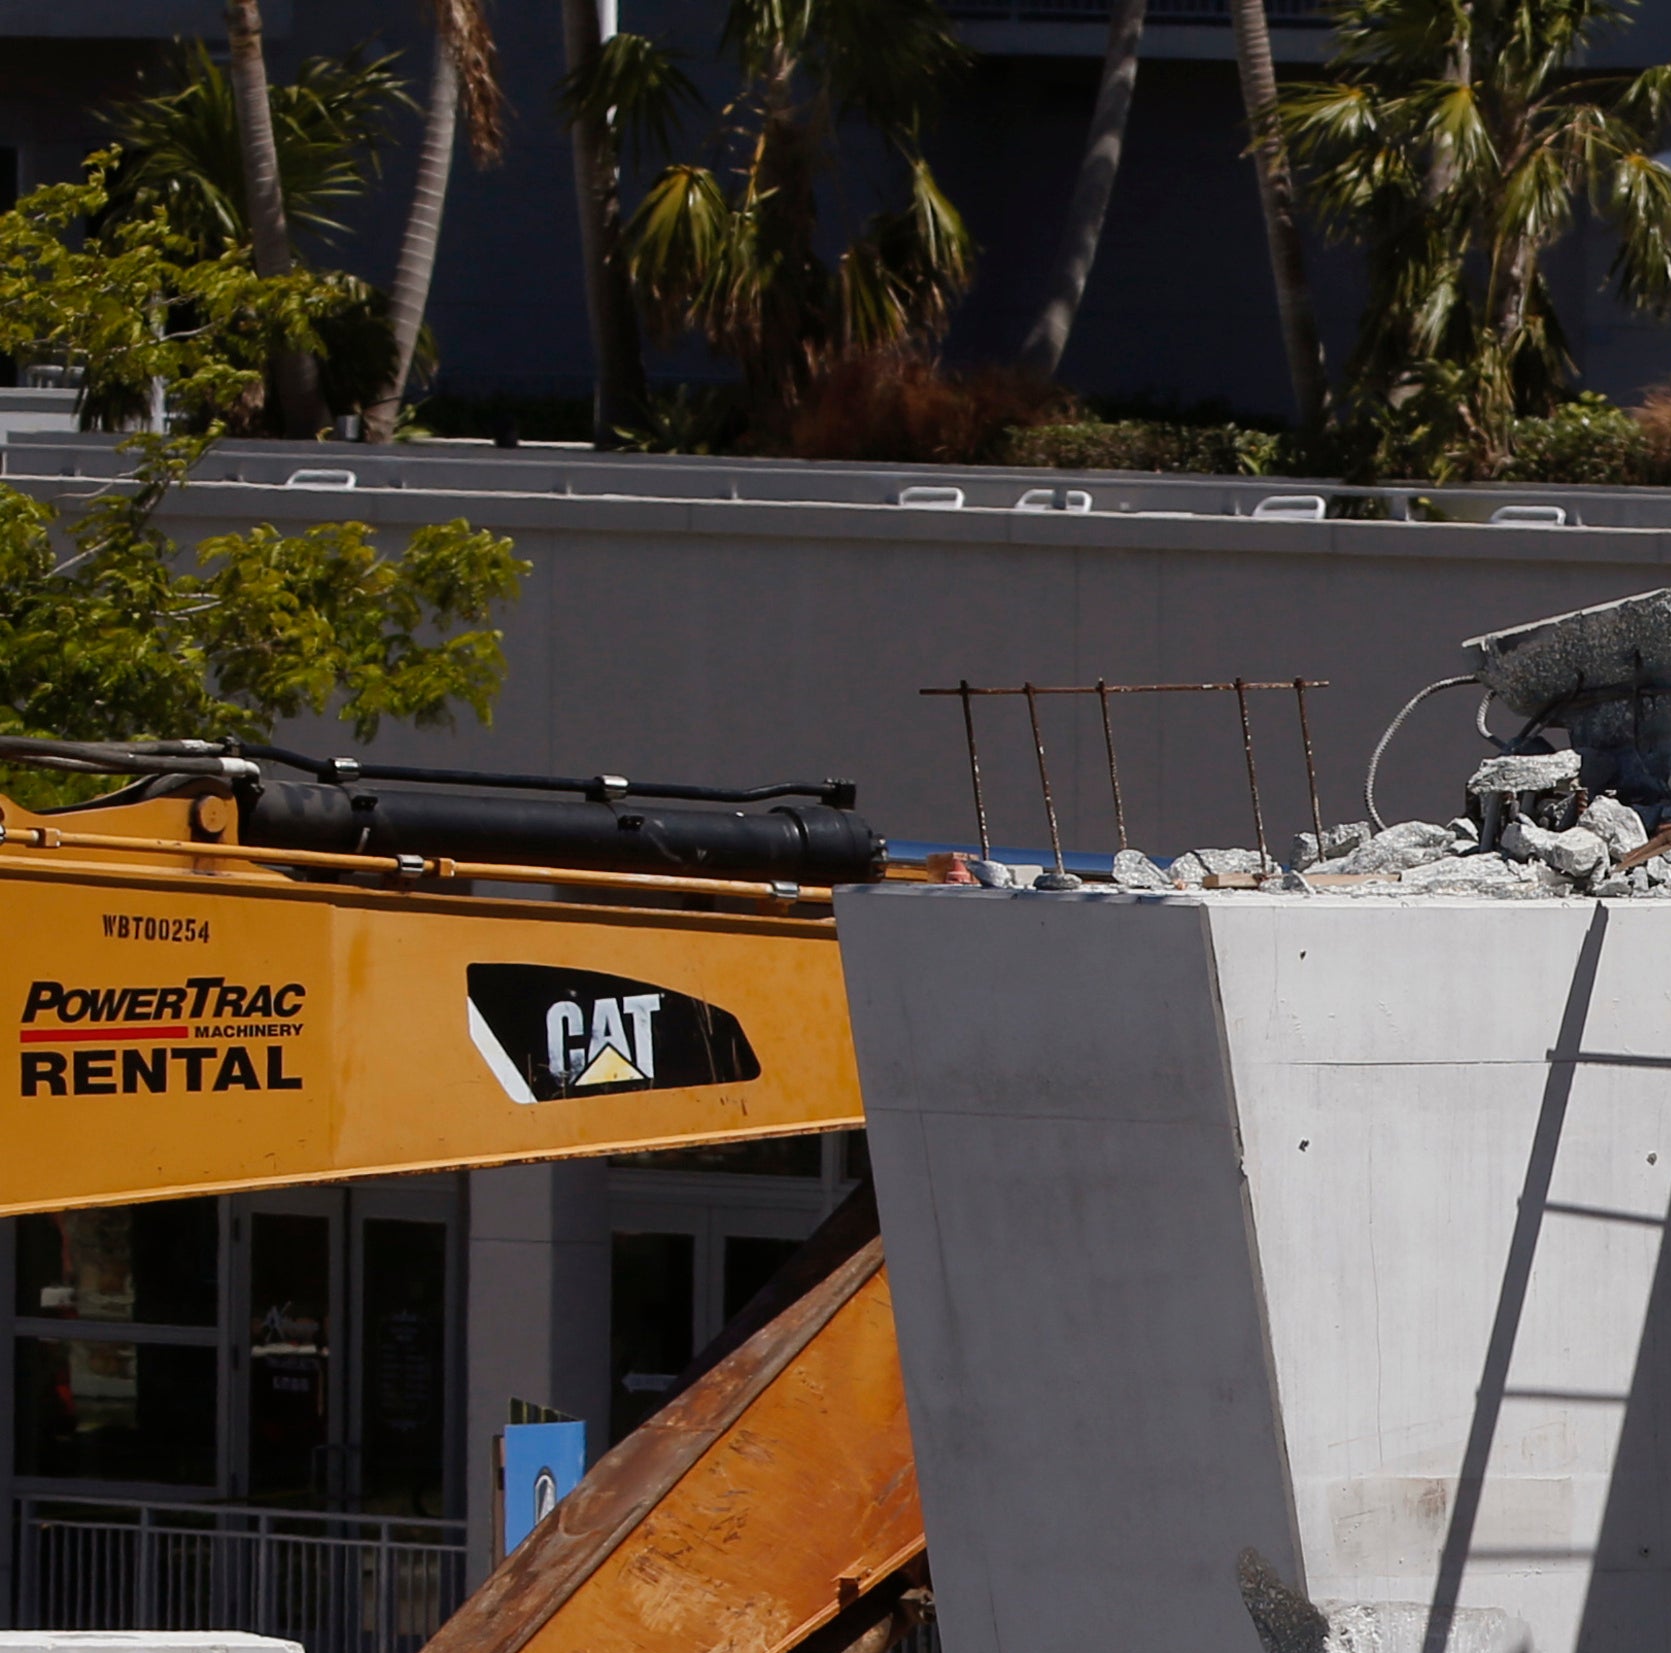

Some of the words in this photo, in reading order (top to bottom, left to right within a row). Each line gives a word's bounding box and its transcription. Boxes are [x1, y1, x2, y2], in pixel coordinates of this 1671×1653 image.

[103, 914, 210, 944] WBT00254
[194, 1023, 304, 1040] MACHINERY
[546, 993, 664, 1085] CAT
[20, 1047, 302, 1097] RENTAL
